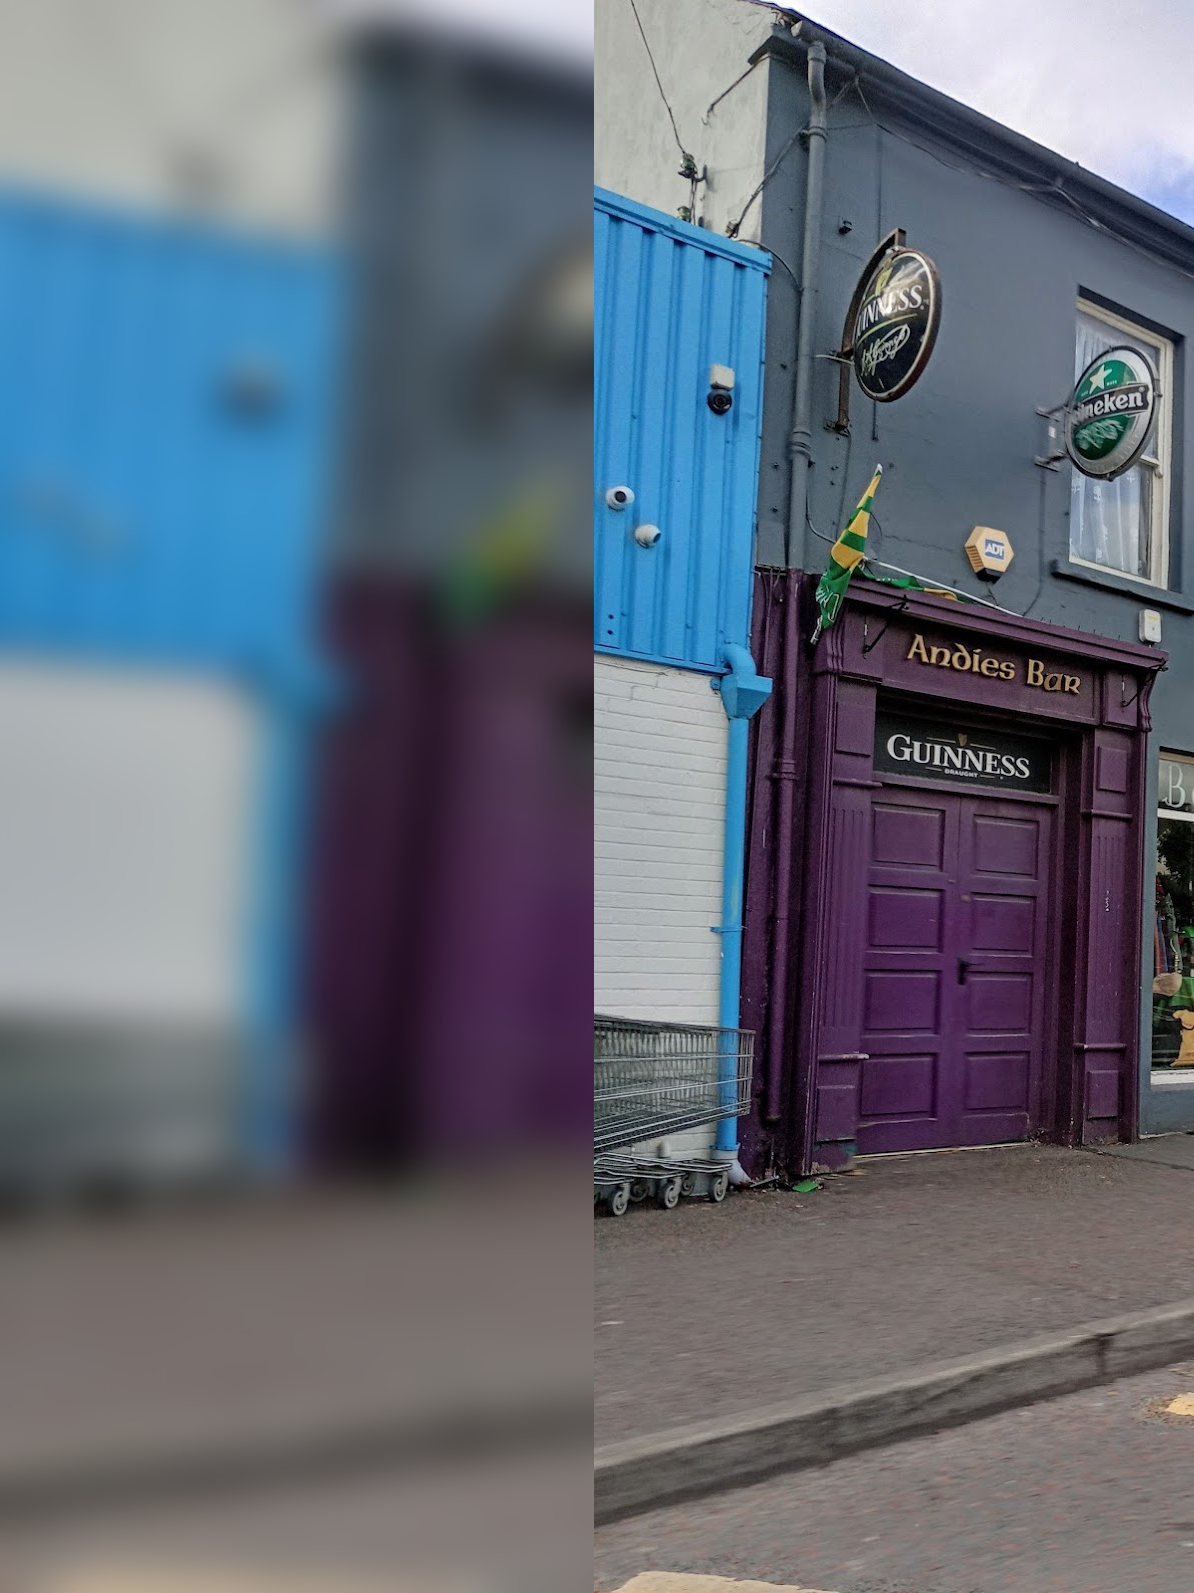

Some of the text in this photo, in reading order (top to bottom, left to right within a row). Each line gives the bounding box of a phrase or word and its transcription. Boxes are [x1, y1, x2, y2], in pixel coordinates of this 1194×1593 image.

[985, 543, 1005, 557] ADT
[886, 734, 1031, 780] GUINNESS
[944, 768, 979, 778] DRAUGHT
